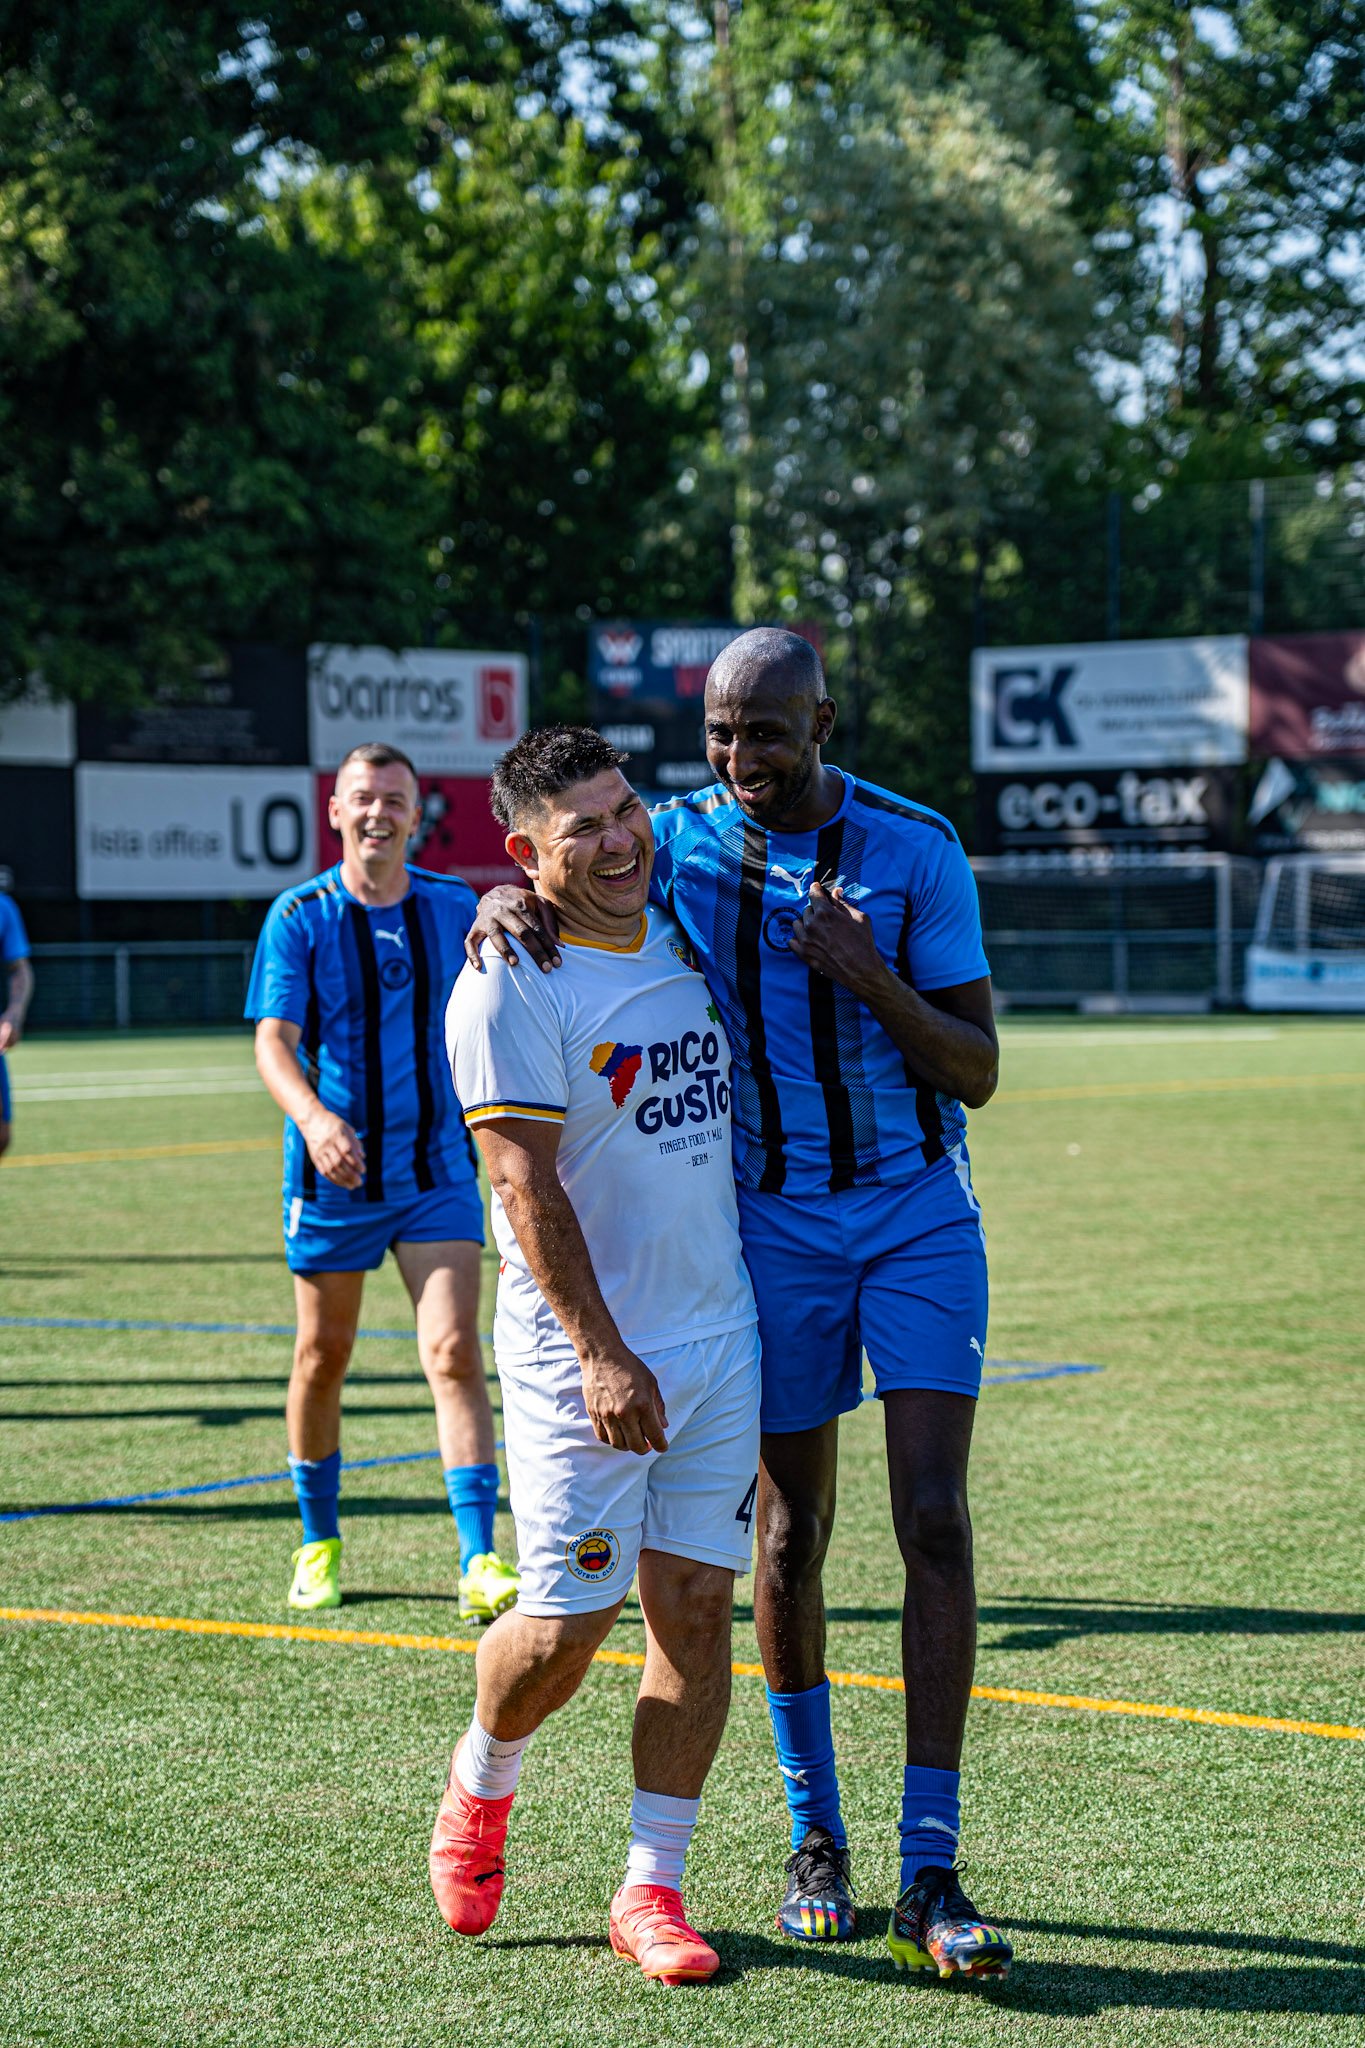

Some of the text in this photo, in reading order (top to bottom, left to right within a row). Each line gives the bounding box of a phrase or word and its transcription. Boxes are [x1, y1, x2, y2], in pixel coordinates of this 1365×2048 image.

[998, 772, 1208, 829] eco-tax
[149, 823, 222, 858] office
[647, 1031, 719, 1084] RICO
[635, 1069, 729, 1135] GUSTO
[659, 1137, 688, 1155] FINGER
[688, 1130, 707, 1148] FOOD
[707, 1132, 712, 1142] Y
[735, 1473, 758, 1533] 4
[569, 1531, 614, 1552] COLOMBIA FC
